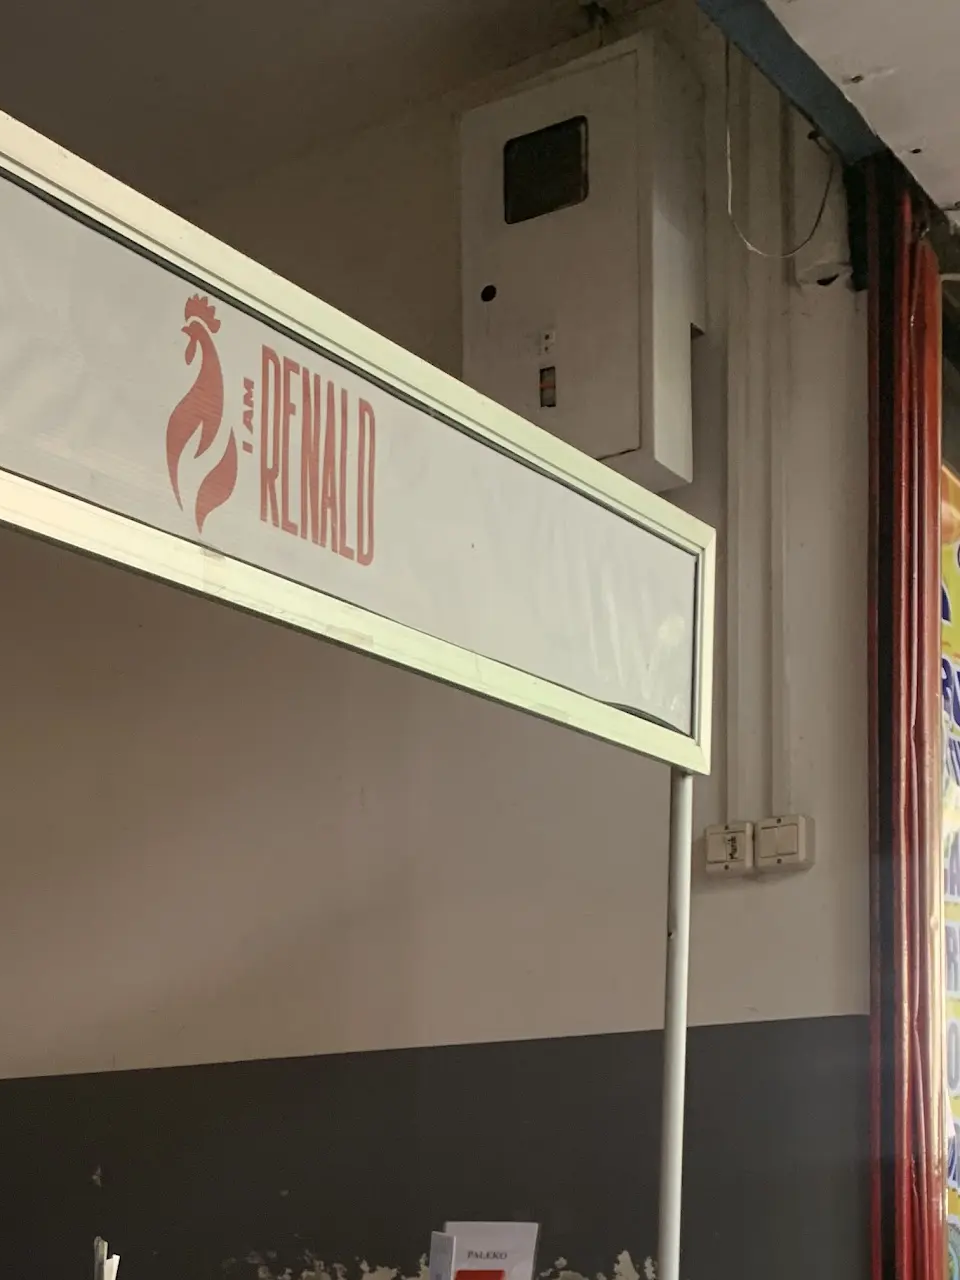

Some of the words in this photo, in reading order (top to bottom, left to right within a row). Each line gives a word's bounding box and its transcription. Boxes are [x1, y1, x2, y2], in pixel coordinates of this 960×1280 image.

[243, 376, 255, 435] AM
[260, 344, 375, 566] RENALD
[467, 1250, 508, 1260] PALEKO
